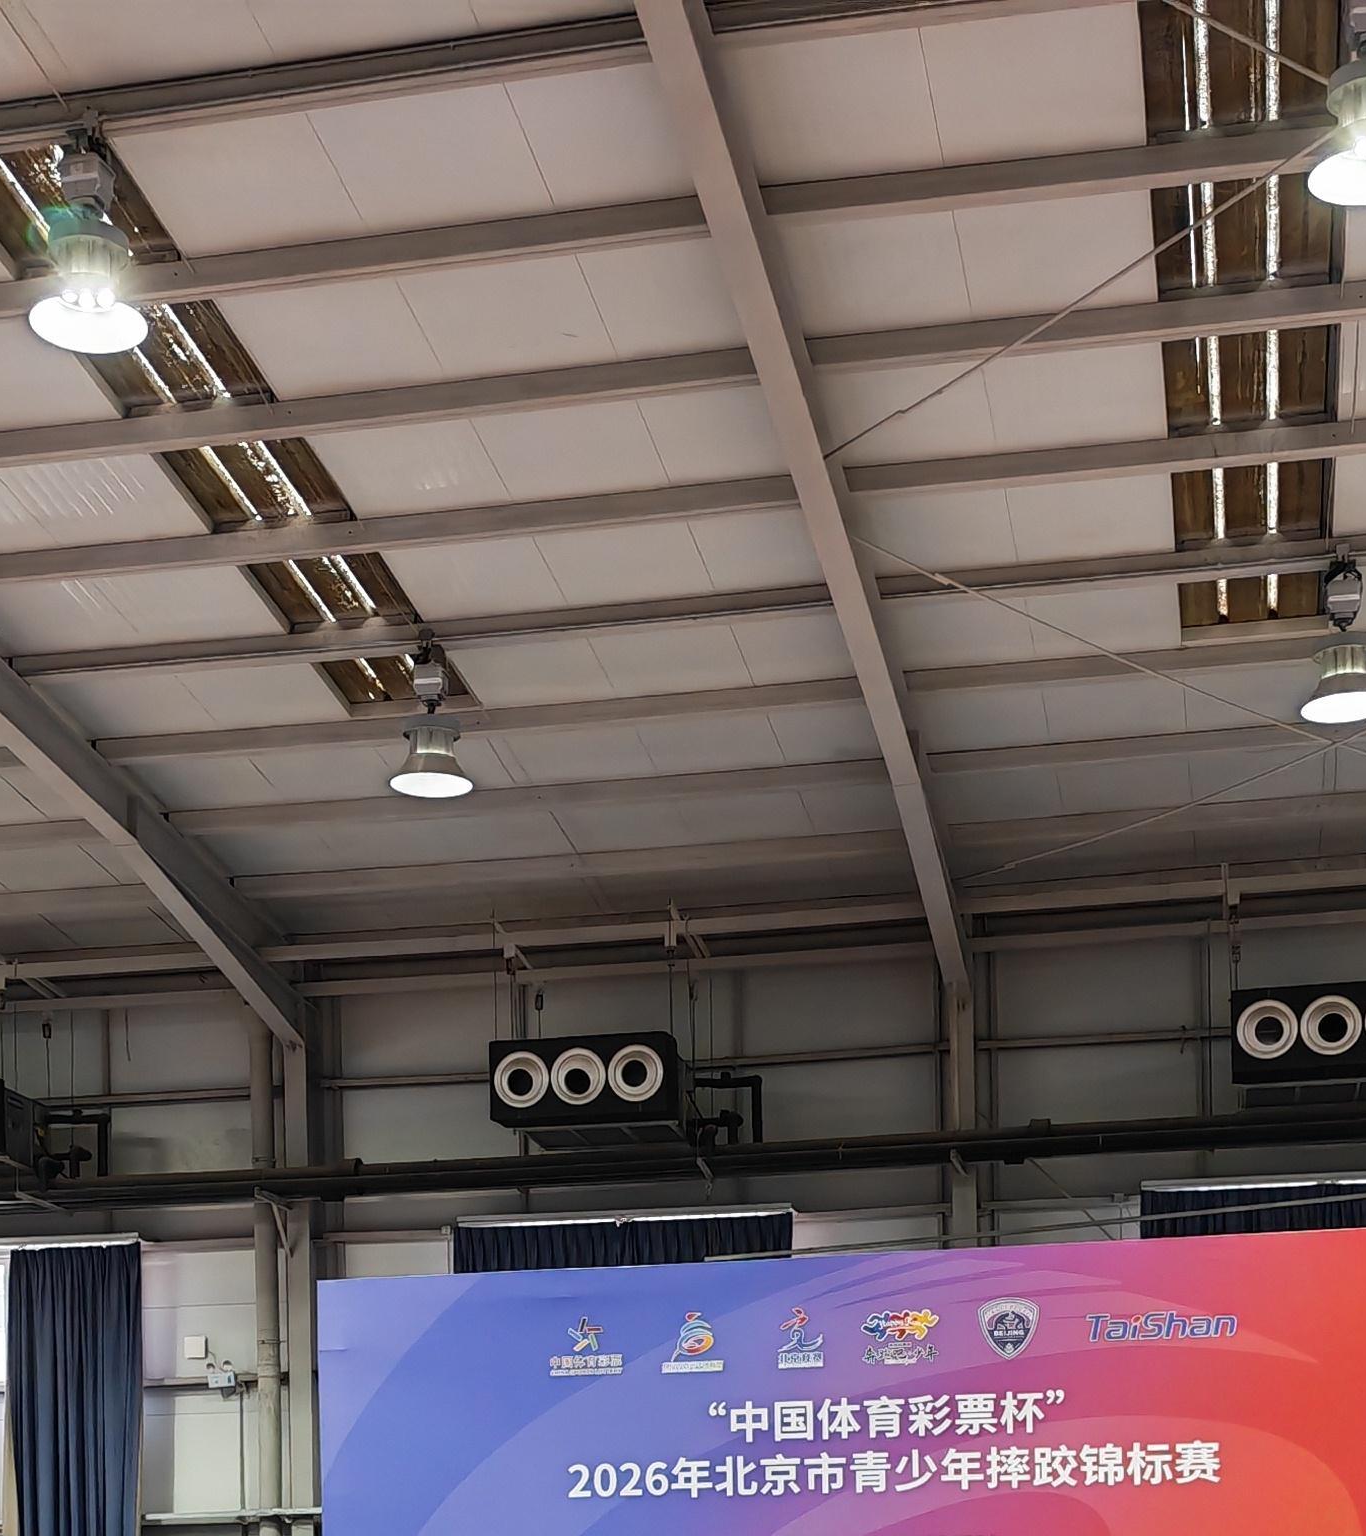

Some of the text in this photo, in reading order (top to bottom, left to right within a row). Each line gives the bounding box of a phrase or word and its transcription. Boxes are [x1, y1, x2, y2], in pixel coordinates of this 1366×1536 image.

[1085, 1311, 1236, 1342] TaiShan
[709, 1390, 1066, 1443] “中国体育彩票杯”
[567, 1440, 1222, 1499] 2026年北京市青少年摔跤锦标赛
